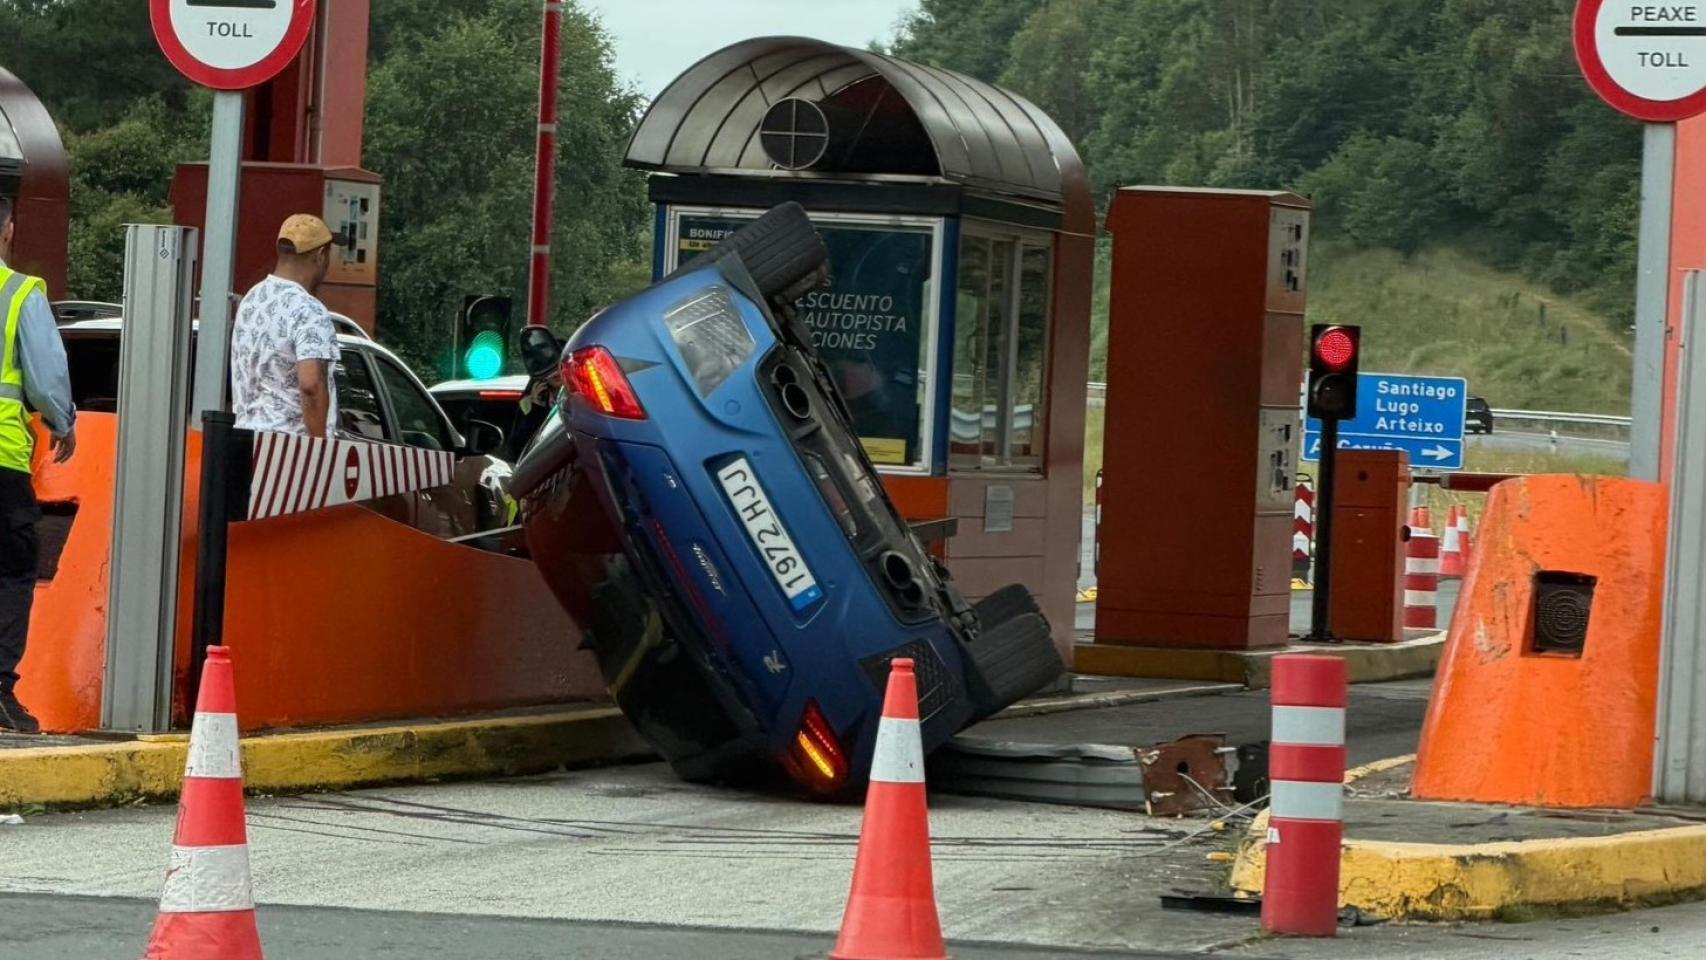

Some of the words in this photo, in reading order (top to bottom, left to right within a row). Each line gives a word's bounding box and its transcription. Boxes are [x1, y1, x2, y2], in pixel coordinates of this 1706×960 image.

[1631, 6, 1697, 21] PEAXE
[206, 21, 253, 38] TOLL
[1637, 52, 1689, 67] TOLL
[795, 292, 893, 312] ESCUENTO
[804, 312, 907, 333] AUTOPISTA
[810, 331, 878, 350] CIONES
[1377, 380, 1457, 399] Santiago
[1376, 398, 1419, 415] Lugo
[1375, 416, 1444, 433] Arteixo
[723, 469, 768, 522] HJJ
[757, 523, 806, 589] 1972
